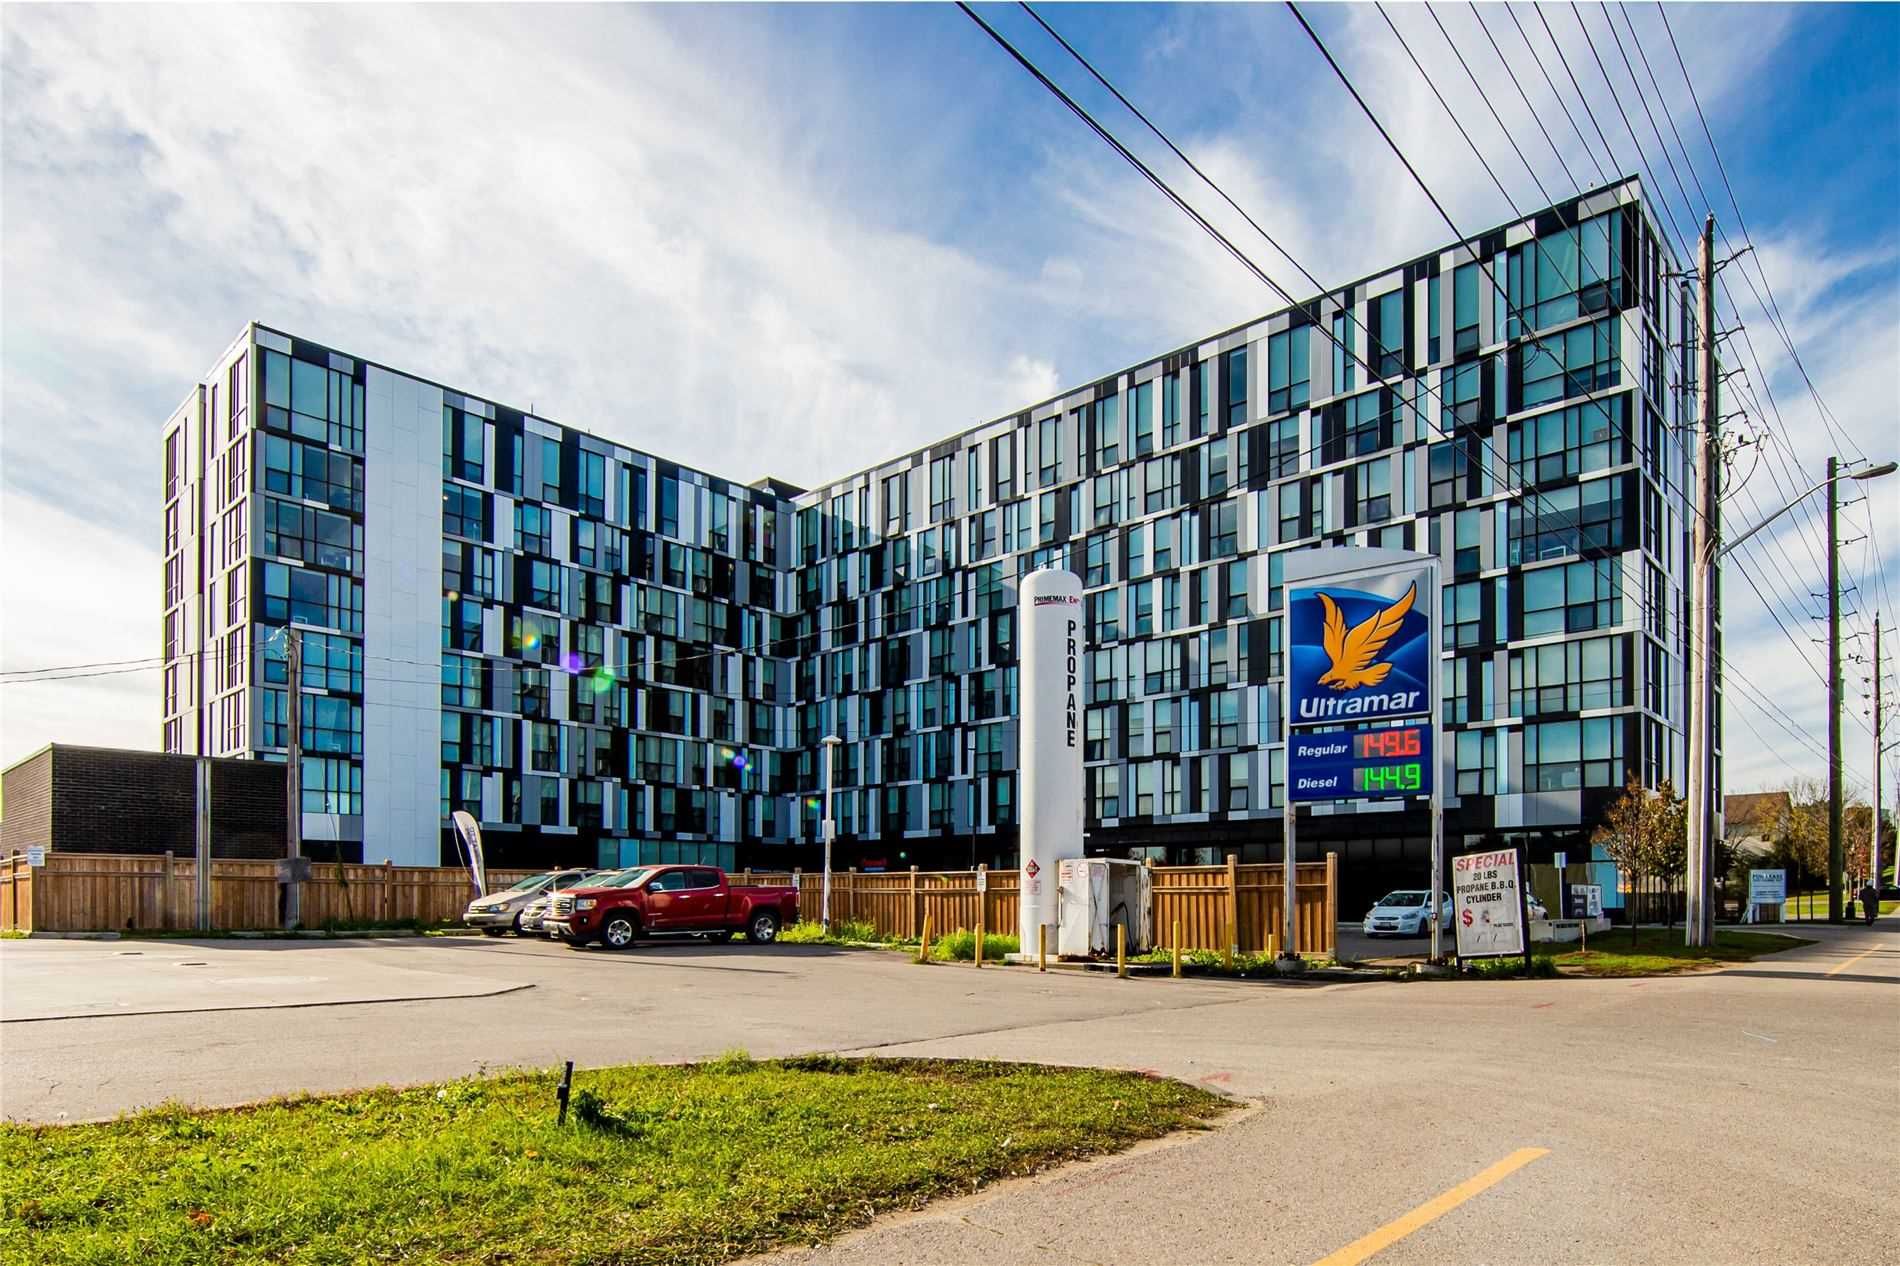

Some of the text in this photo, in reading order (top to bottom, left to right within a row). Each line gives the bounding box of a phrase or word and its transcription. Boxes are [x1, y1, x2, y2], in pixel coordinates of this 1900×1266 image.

[1034, 595, 1067, 603] PRIMEMAX
[1067, 619, 1076, 747] PROPANE
[1300, 691, 1420, 718] Ultramar
[1298, 744, 1348, 757] Regular
[1298, 764, 1421, 791] Diesel 144.9
[1456, 852, 1514, 872] SPECIAL
[1483, 870, 1498, 880] LBS
[1457, 881, 1489, 894] PROPANE
[1466, 893, 1502, 904] CYLINDER
